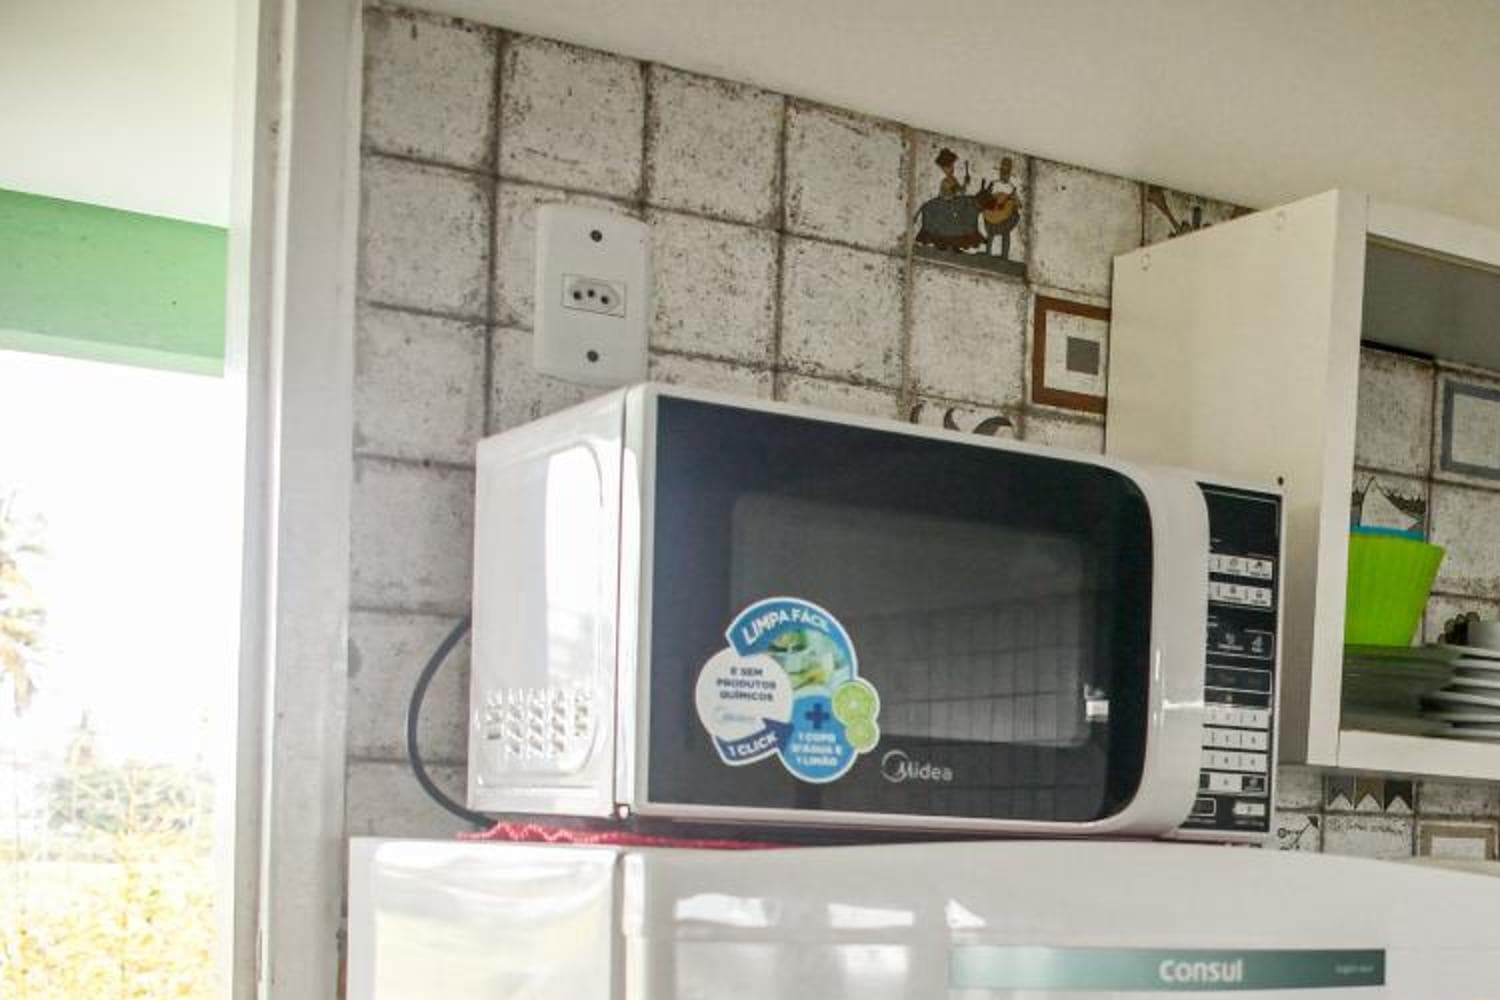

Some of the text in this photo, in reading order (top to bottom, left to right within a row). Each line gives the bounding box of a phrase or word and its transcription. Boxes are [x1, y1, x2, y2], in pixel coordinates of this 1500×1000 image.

[742, 609, 789, 645] LIMPA
[740, 667, 763, 676] SEM
[716, 678, 777, 689] PRODUTOS
[738, 732, 777, 756] CLICK
[899, 760, 952, 781] Midea
[1159, 959, 1243, 982] Consul
